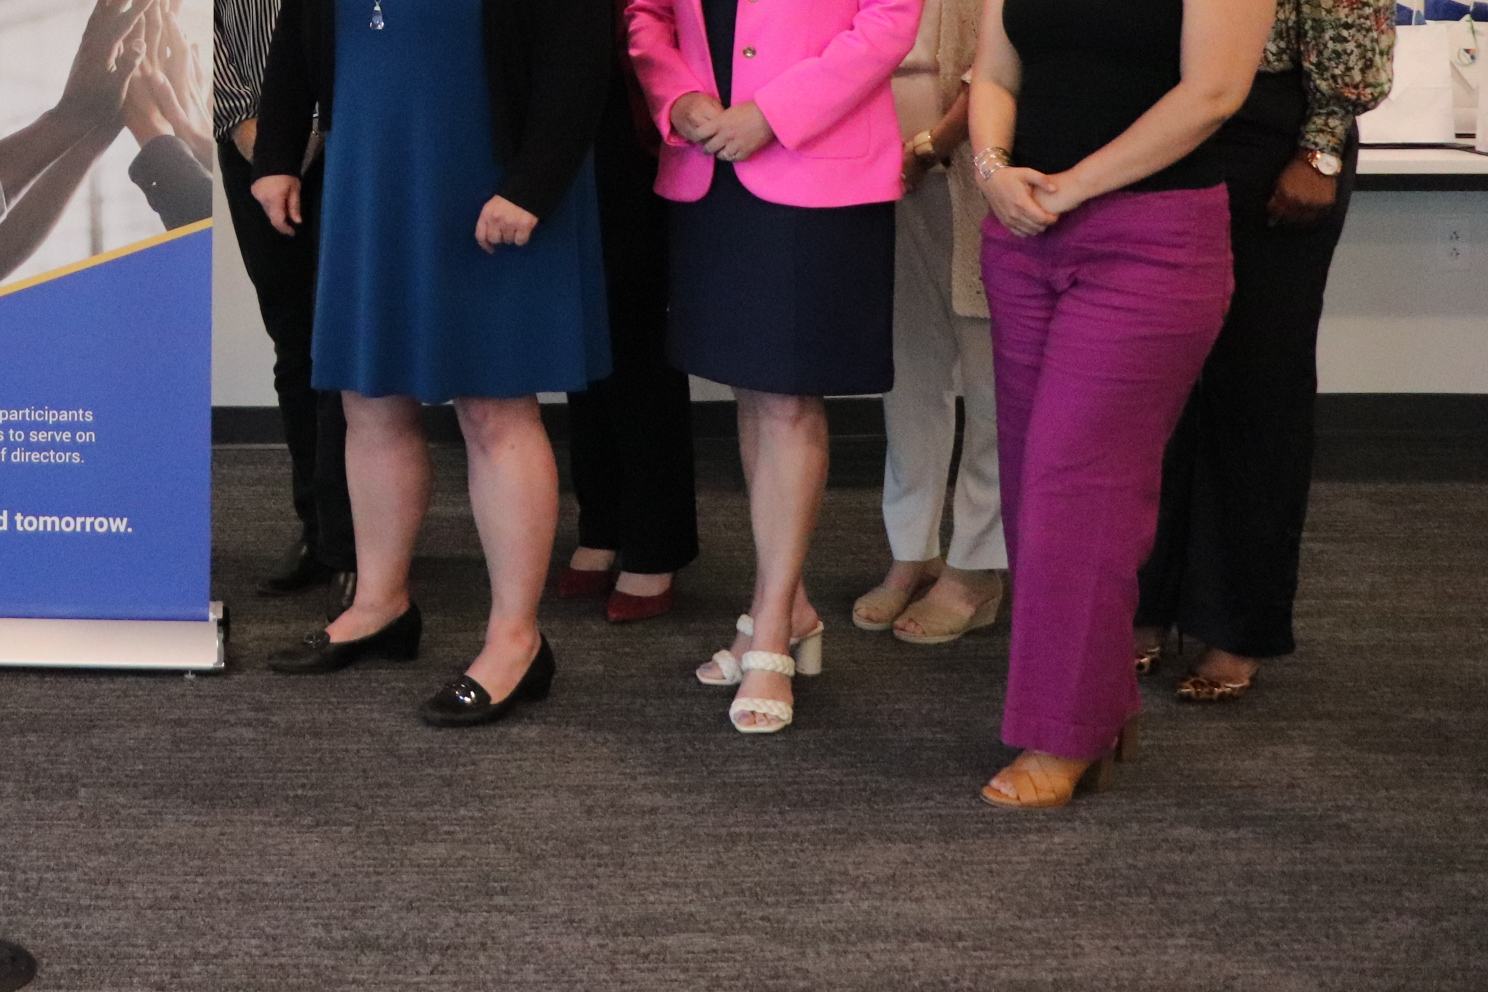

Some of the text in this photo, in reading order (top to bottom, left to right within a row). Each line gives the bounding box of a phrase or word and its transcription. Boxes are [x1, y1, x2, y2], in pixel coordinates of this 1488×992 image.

[0, 406, 93, 424] participants
[9, 429, 24, 442] to
[30, 432, 71, 442] serve
[76, 431, 95, 442] on
[11, 448, 84, 463] directors.
[15, 513, 132, 533] tomorrow.
